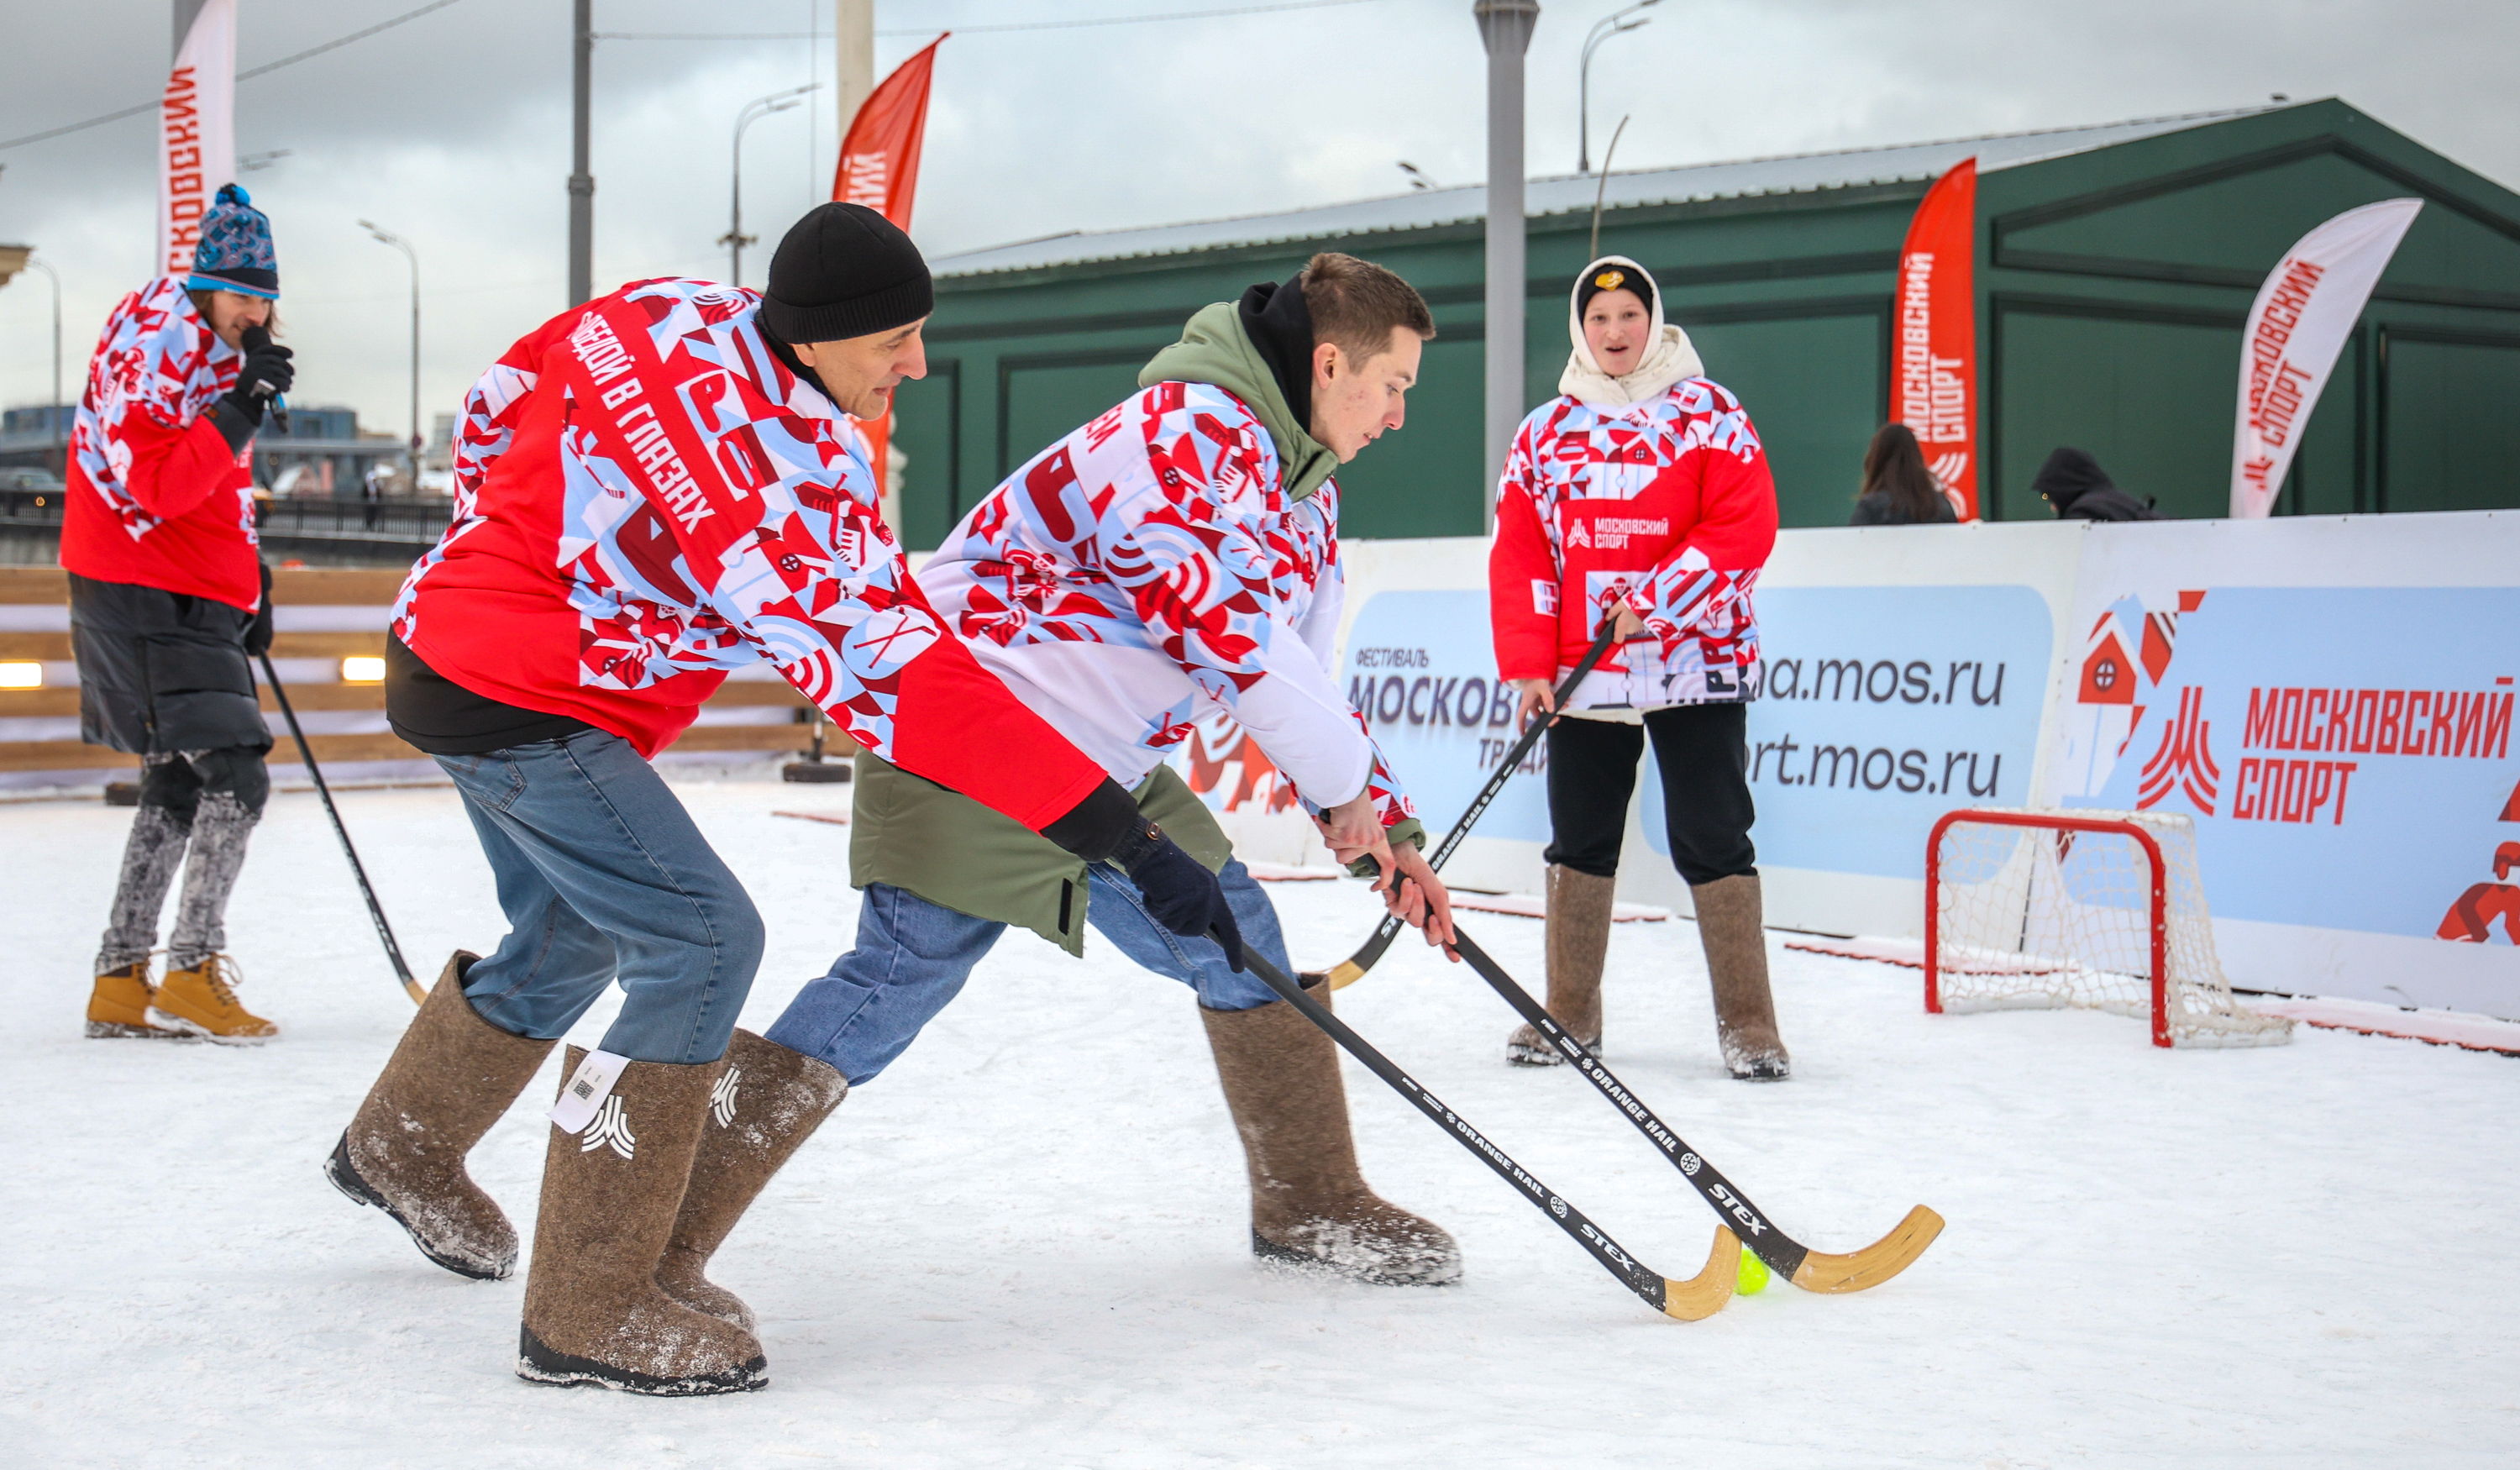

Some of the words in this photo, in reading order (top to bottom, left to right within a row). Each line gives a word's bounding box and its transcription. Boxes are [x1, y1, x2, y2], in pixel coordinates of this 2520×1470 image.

[601, 377, 643, 411] В
[1930, 353, 1966, 444] СПОРТ
[2260, 358, 2313, 449] СПОРТ
[615, 402, 717, 536] ГЛАЗАХ
[1594, 517, 1670, 536] МОСКОВСКИЙ
[1594, 533, 1630, 550] СПОРТ
[1355, 648, 1430, 668] ФЕСТИВАЛЬ
[1347, 674, 1522, 727] МОСКОВ
[2242, 676, 2516, 760] МОСКОВСКИЙ
[1745, 732, 2002, 797] rt.mos.ru
[2232, 758, 2358, 826] СПОРТ
[1431, 826, 1466, 870] ORANGE
[1463, 802, 1484, 828] HAIL
[1591, 1068, 1648, 1122] ORANGE
[1645, 1119, 1677, 1153] HAIL
[1456, 1120, 1513, 1171] ORANGE
[1513, 1167, 1545, 1198] HAIL
[1708, 1183, 1768, 1236] STEX
[1580, 1223, 1635, 1273] STEX
